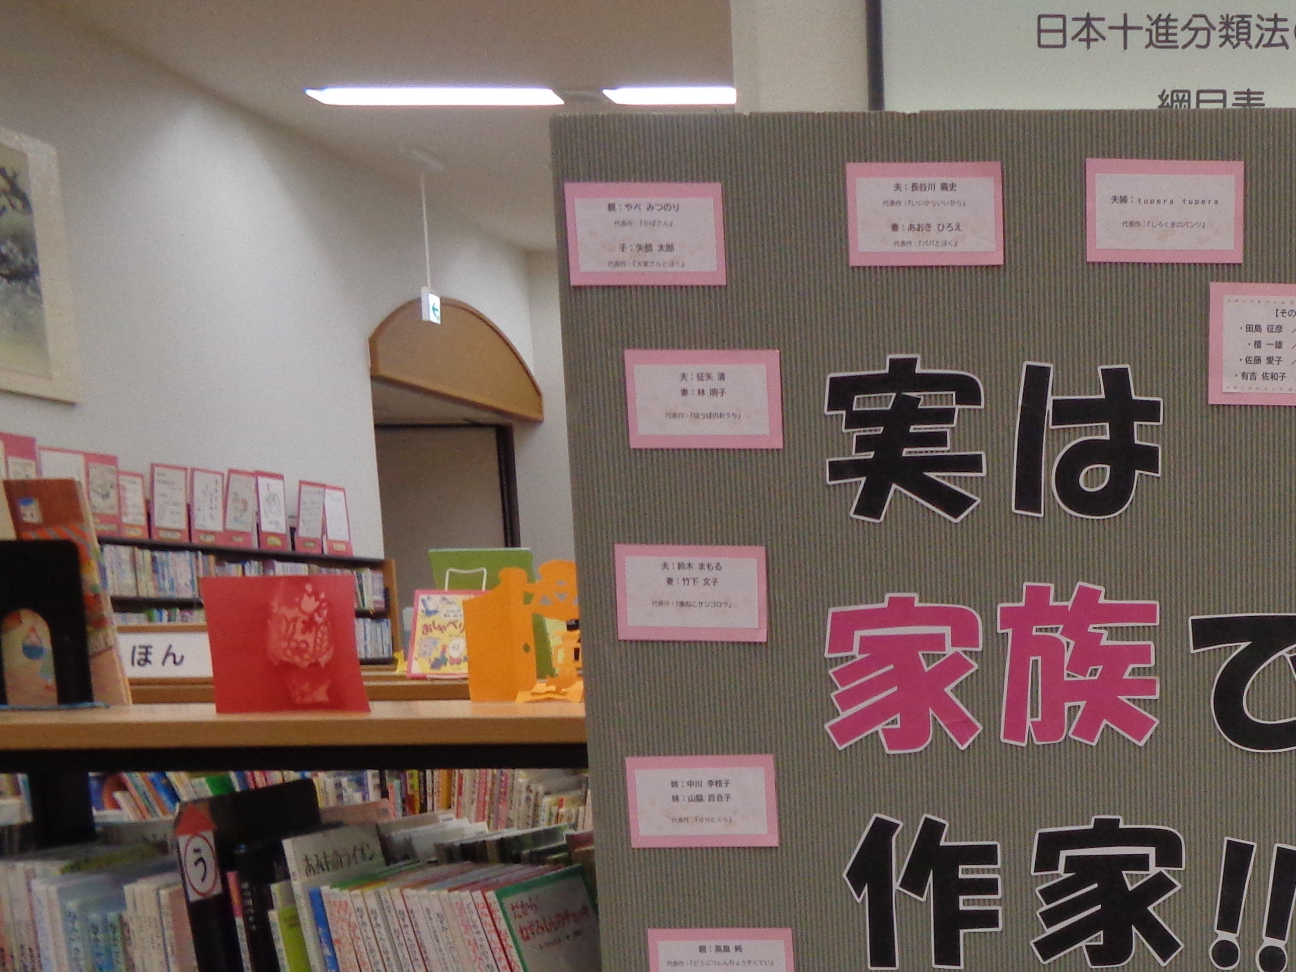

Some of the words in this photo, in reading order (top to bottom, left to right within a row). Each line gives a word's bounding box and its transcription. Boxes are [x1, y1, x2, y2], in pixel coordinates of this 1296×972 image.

[937, 223, 962, 232] ひろえ
[1266, 340, 1283, 349] 一雄
[1266, 356, 1283, 365] 愛子
[1262, 371, 1286, 382] 佐和子
[710, 388, 727, 397] 明子
[826, 353, 1163, 520] 実は
[702, 577, 719, 586] 文子
[131, 644, 184, 666] ほん
